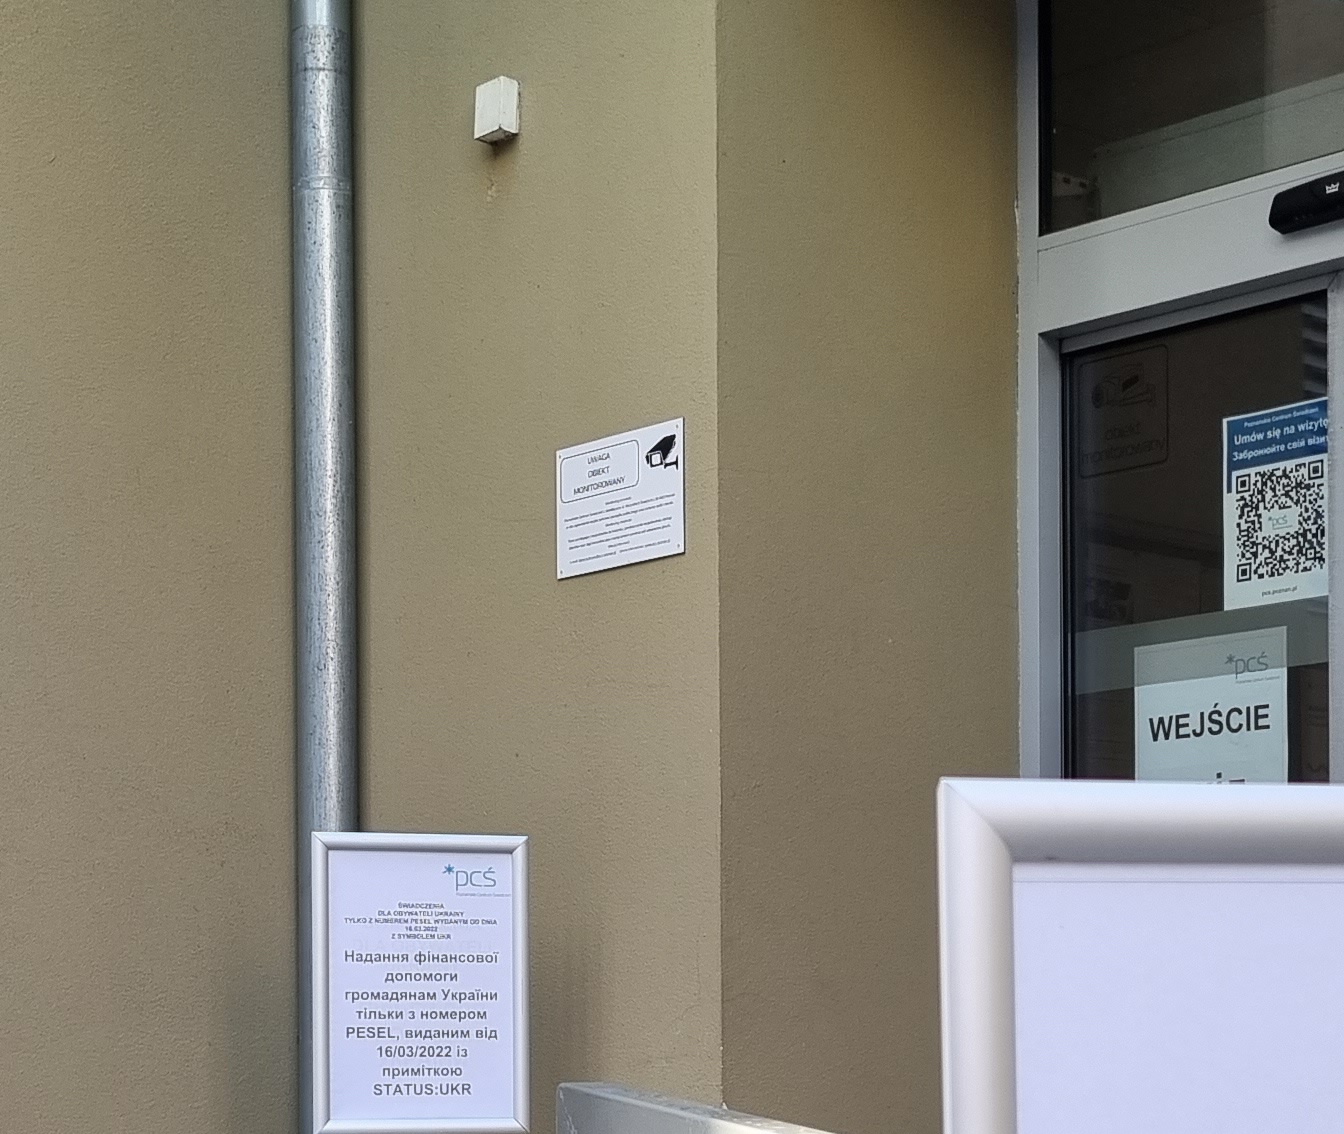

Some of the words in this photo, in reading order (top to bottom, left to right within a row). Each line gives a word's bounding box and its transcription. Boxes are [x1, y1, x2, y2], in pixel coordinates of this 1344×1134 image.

[1234, 431, 1264, 445] Umów
[1267, 427, 1281, 439] się
[1283, 425, 1295, 435] na
[1287, 438, 1305, 450] свій
[588, 453, 610, 464] UWAGA
[1235, 652, 1269, 679] pcś
[1149, 703, 1270, 742] WEJŚCIE
[456, 867, 496, 891] pcś
[345, 950, 408, 964] Надання
[414, 951, 499, 965] фінансової
[384, 972, 458, 983] допомоги
[345, 991, 437, 1003] громадянам
[441, 989, 498, 1003] України
[356, 1008, 404, 1019] тільки
[408, 1010, 415, 1019] з
[420, 1010, 487, 1022] номером
[346, 1027, 400, 1040] PESEL,
[405, 1029, 470, 1040] виданим
[475, 1027, 498, 1040] від
[376, 1046, 452, 1058] 16/03/2022
[456, 1045, 468, 1058] із
[382, 1064, 462, 1079] приміткою
[373, 1083, 472, 1096] STATUS:UKR
